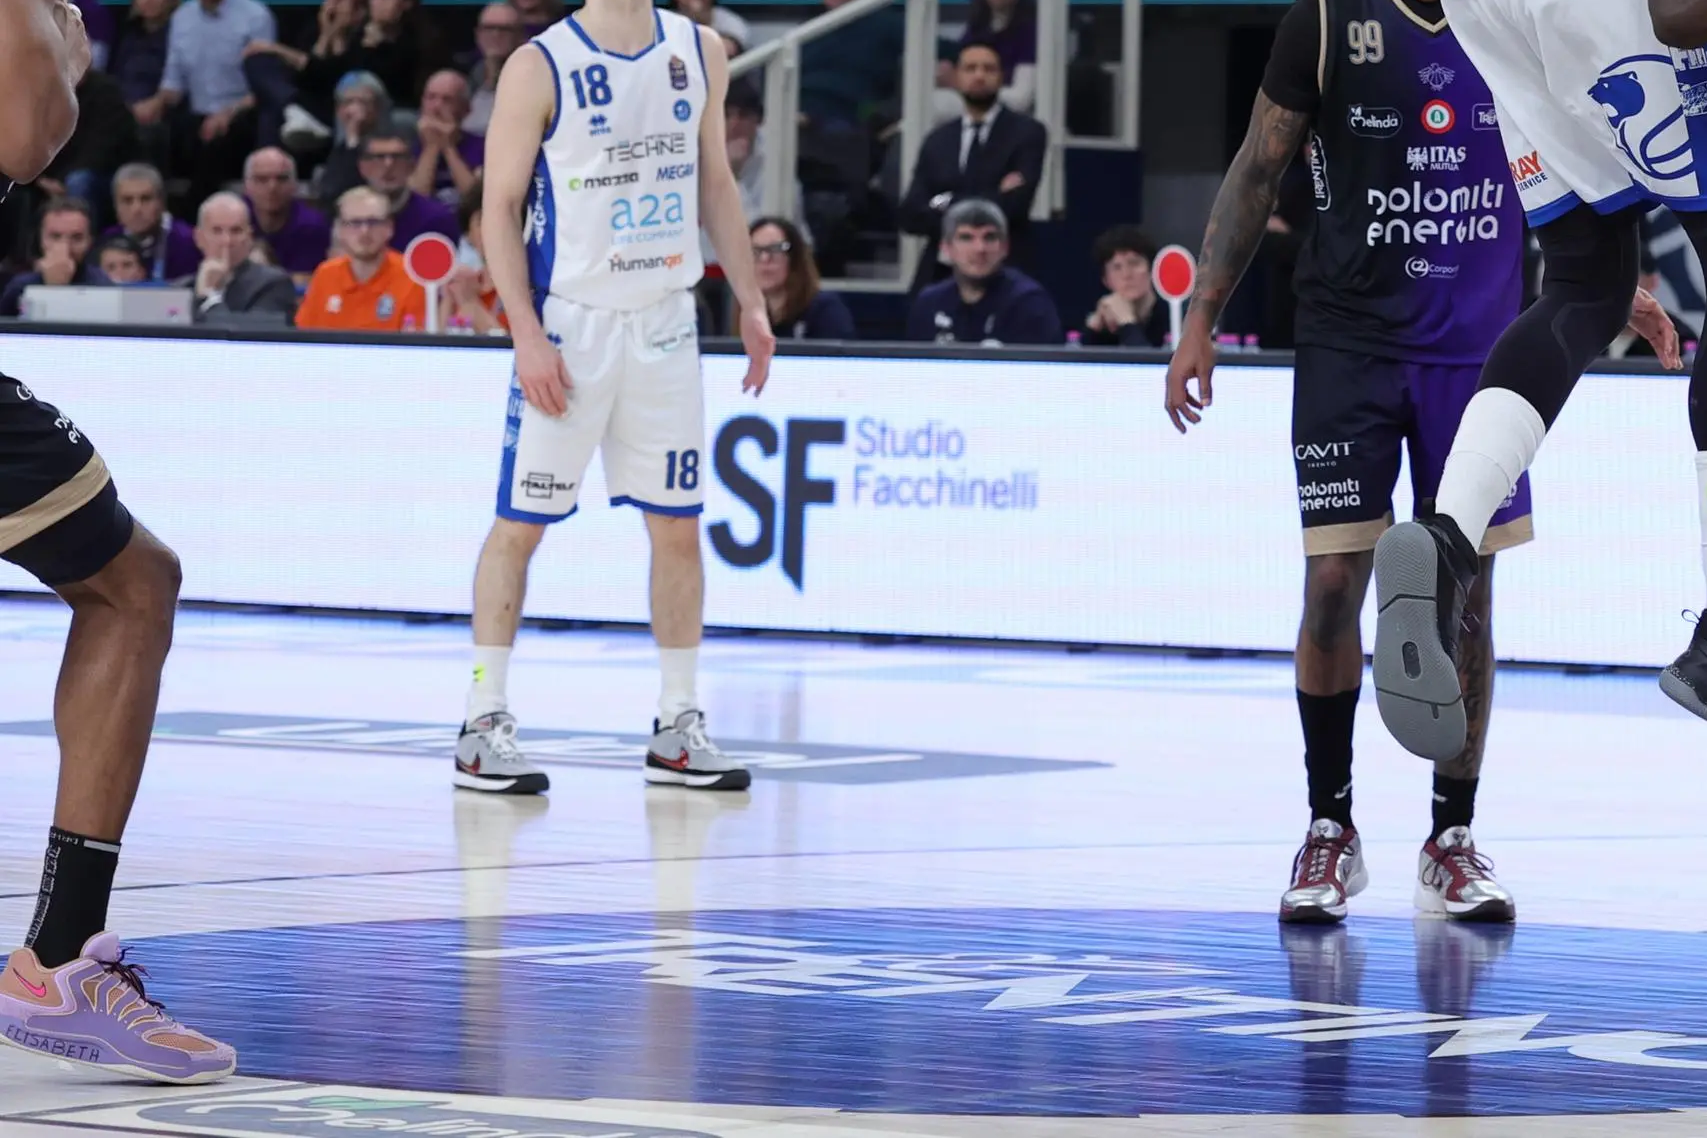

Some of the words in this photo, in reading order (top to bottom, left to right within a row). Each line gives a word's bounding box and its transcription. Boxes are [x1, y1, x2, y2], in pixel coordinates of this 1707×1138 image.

[1348, 20, 1384, 64] 99
[570, 64, 613, 109] 18
[1430, 146, 1466, 163] ITAS
[1430, 162, 1460, 171] MUTUA
[610, 191, 685, 231] a2a
[855, 416, 964, 460] Studio
[1295, 441, 1354, 461] CAVIT
[665, 448, 699, 491] 18
[853, 464, 1039, 511] Facchinelli
[707, 414, 846, 594] SF
[5, 1023, 100, 1063] ELISABETH
